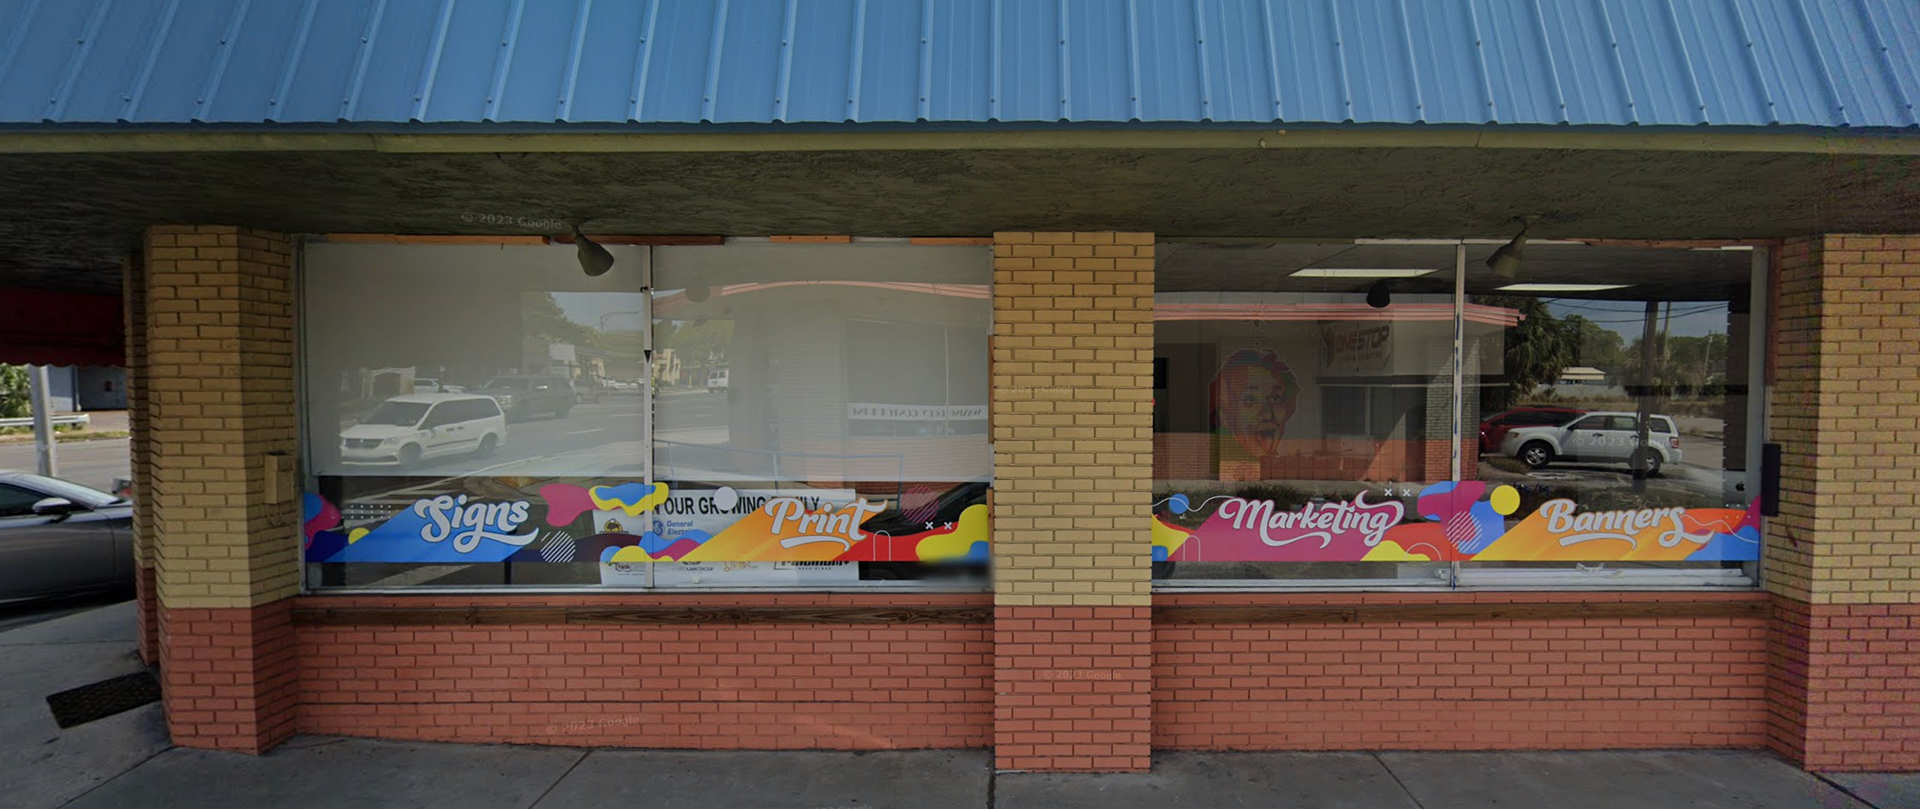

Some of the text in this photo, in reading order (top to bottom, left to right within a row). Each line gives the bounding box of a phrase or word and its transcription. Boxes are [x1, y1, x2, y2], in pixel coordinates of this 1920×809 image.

[414, 494, 539, 553] Signs
[664, 497, 695, 515] OUR
[698, 496, 767, 514] GRWING
[666, 520, 693, 528] General
[764, 497, 888, 551] Print
[1218, 490, 1405, 549] Marketing
[1539, 498, 1714, 549] Banners
